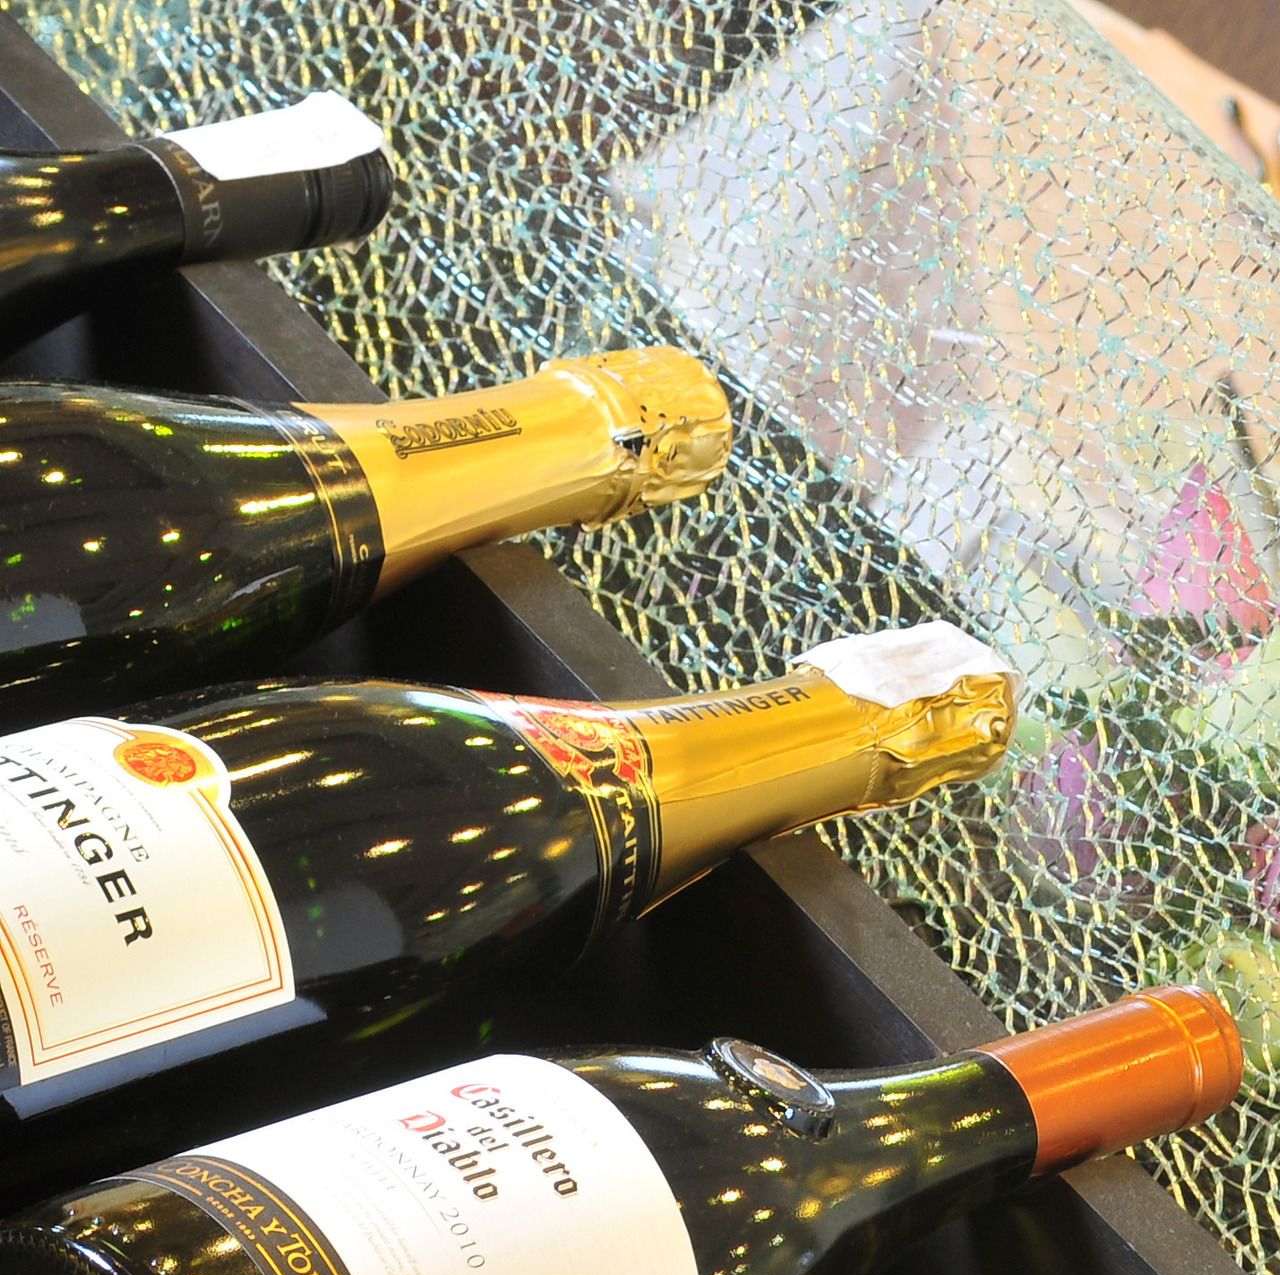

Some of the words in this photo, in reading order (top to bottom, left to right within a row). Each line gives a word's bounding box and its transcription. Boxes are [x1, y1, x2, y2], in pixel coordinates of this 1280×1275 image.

[642, 687, 812, 727] TAITTINGER
[13, 903, 64, 1009] RÉSERVE
[399, 1109, 499, 1202] Diablo
[449, 1083, 579, 1199] Casillero
[465, 1125, 510, 1152] del
[158, 1161, 266, 1221] CONCHA
[260, 1217, 310, 1236] Y
[439, 1206, 486, 1269] 2010
